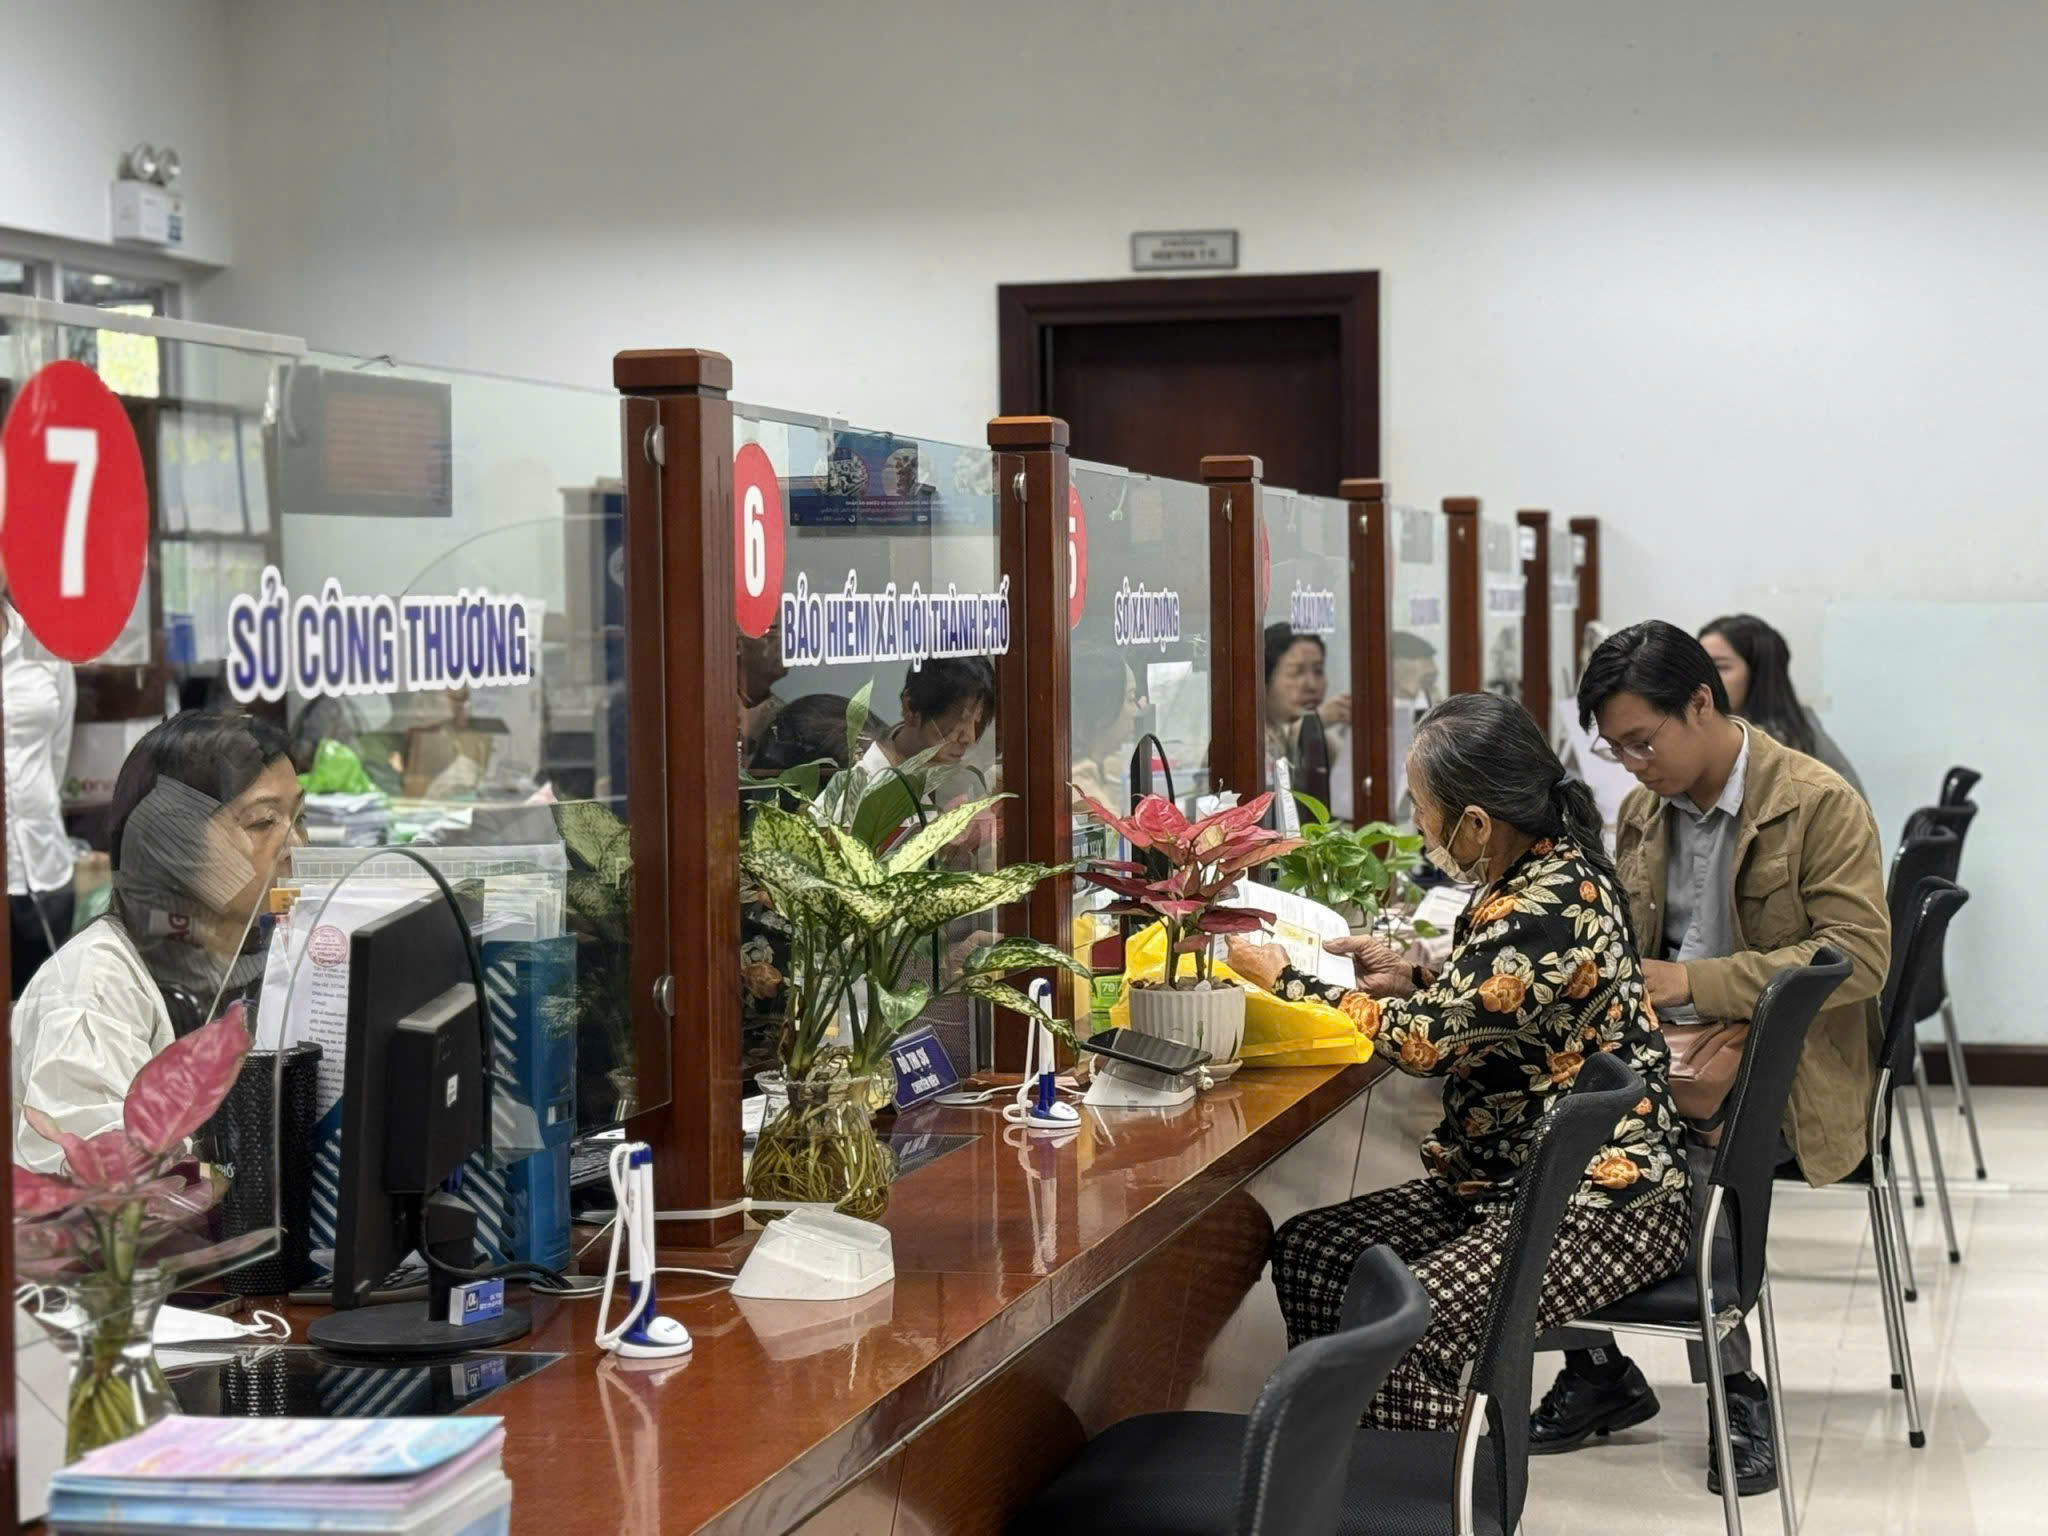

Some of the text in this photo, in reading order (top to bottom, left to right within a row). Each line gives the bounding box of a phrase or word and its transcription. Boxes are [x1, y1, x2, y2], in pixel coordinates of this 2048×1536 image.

[45, 426, 99, 599] 7
[744, 484, 767, 598] 6
[230, 567, 528, 699] SỞ CÔNG THƯƠNG
[783, 570, 1009, 671] BẢO HIỂM XÃ HỘI THÀNH PHỐ
[1115, 577, 1179, 651] SỞ XÂY DỰNG
[1101, 982, 1116, 993] 70
